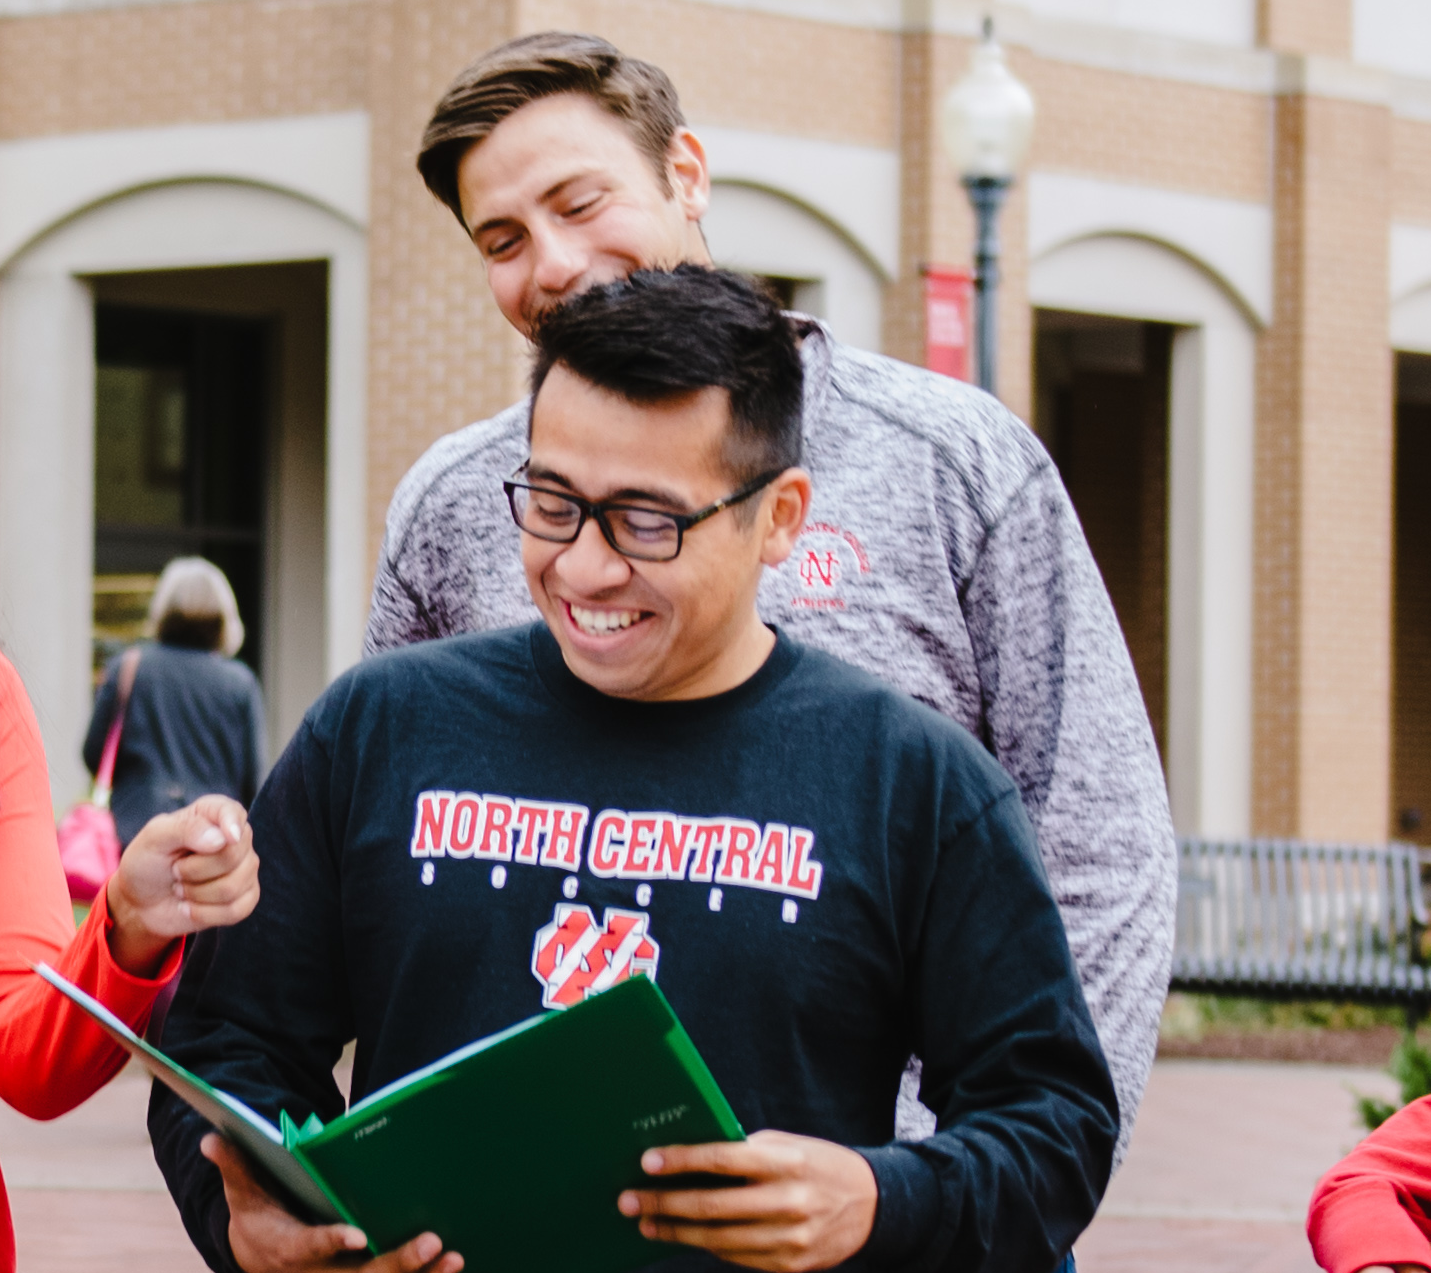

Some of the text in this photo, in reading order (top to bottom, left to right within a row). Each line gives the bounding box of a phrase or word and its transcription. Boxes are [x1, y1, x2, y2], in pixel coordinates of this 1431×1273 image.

[411, 790, 823, 900] NORTH CENTRAL
[421, 861, 798, 923] SOCCER
